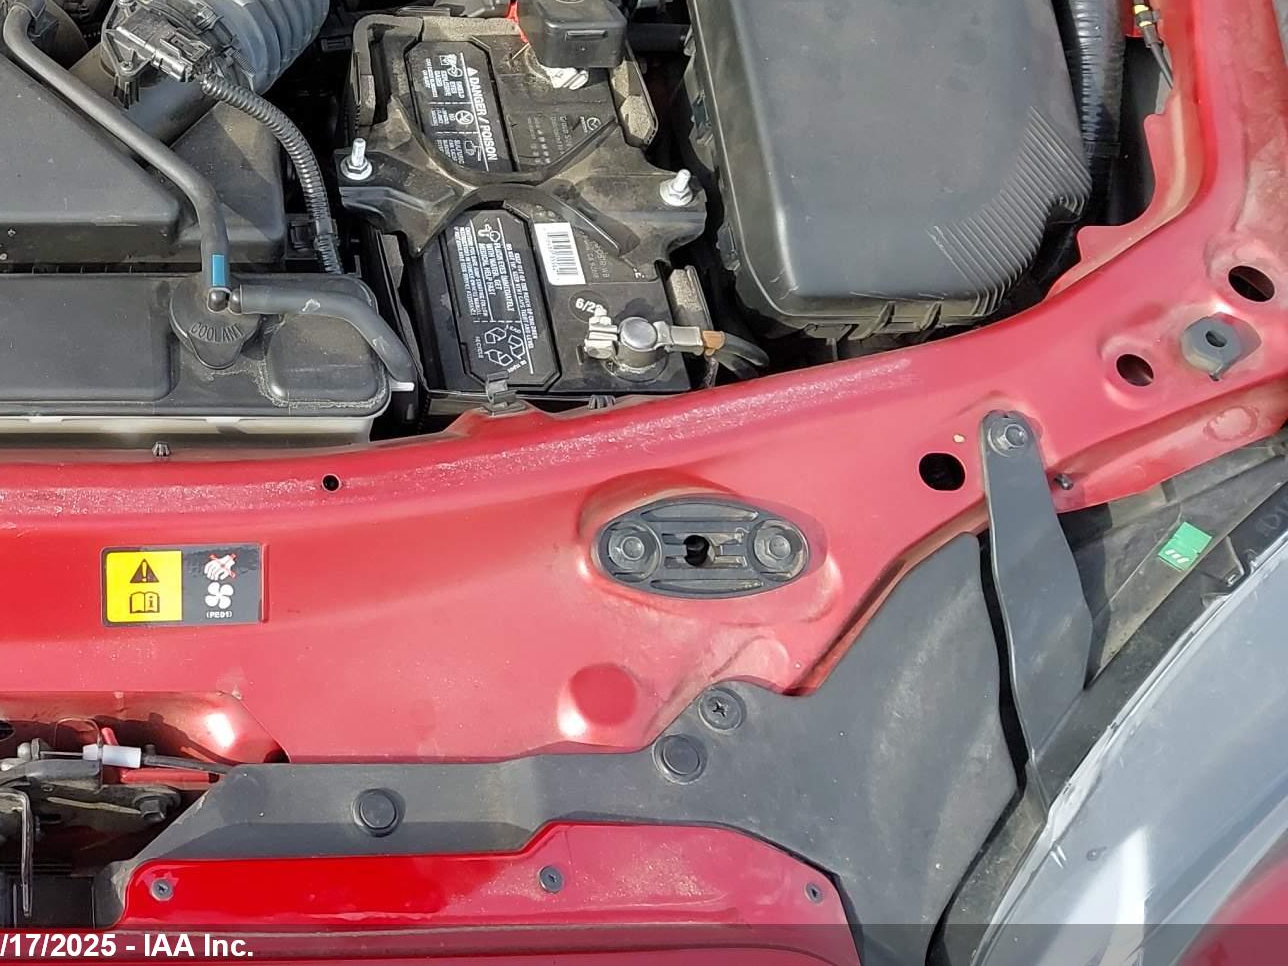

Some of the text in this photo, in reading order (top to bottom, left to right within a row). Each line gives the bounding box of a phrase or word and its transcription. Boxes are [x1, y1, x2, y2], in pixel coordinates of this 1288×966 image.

[468, 77, 487, 115] DANGER
[479, 125, 497, 160] POISON
[478, 242, 495, 295] MEDICAL HELP FAST
[485, 243, 495, 257] WITH
[493, 279, 502, 290] GET
[493, 242, 515, 311] FLUSH EYES IMMEDIATELY
[190, 322, 244, 343] COOLANT
